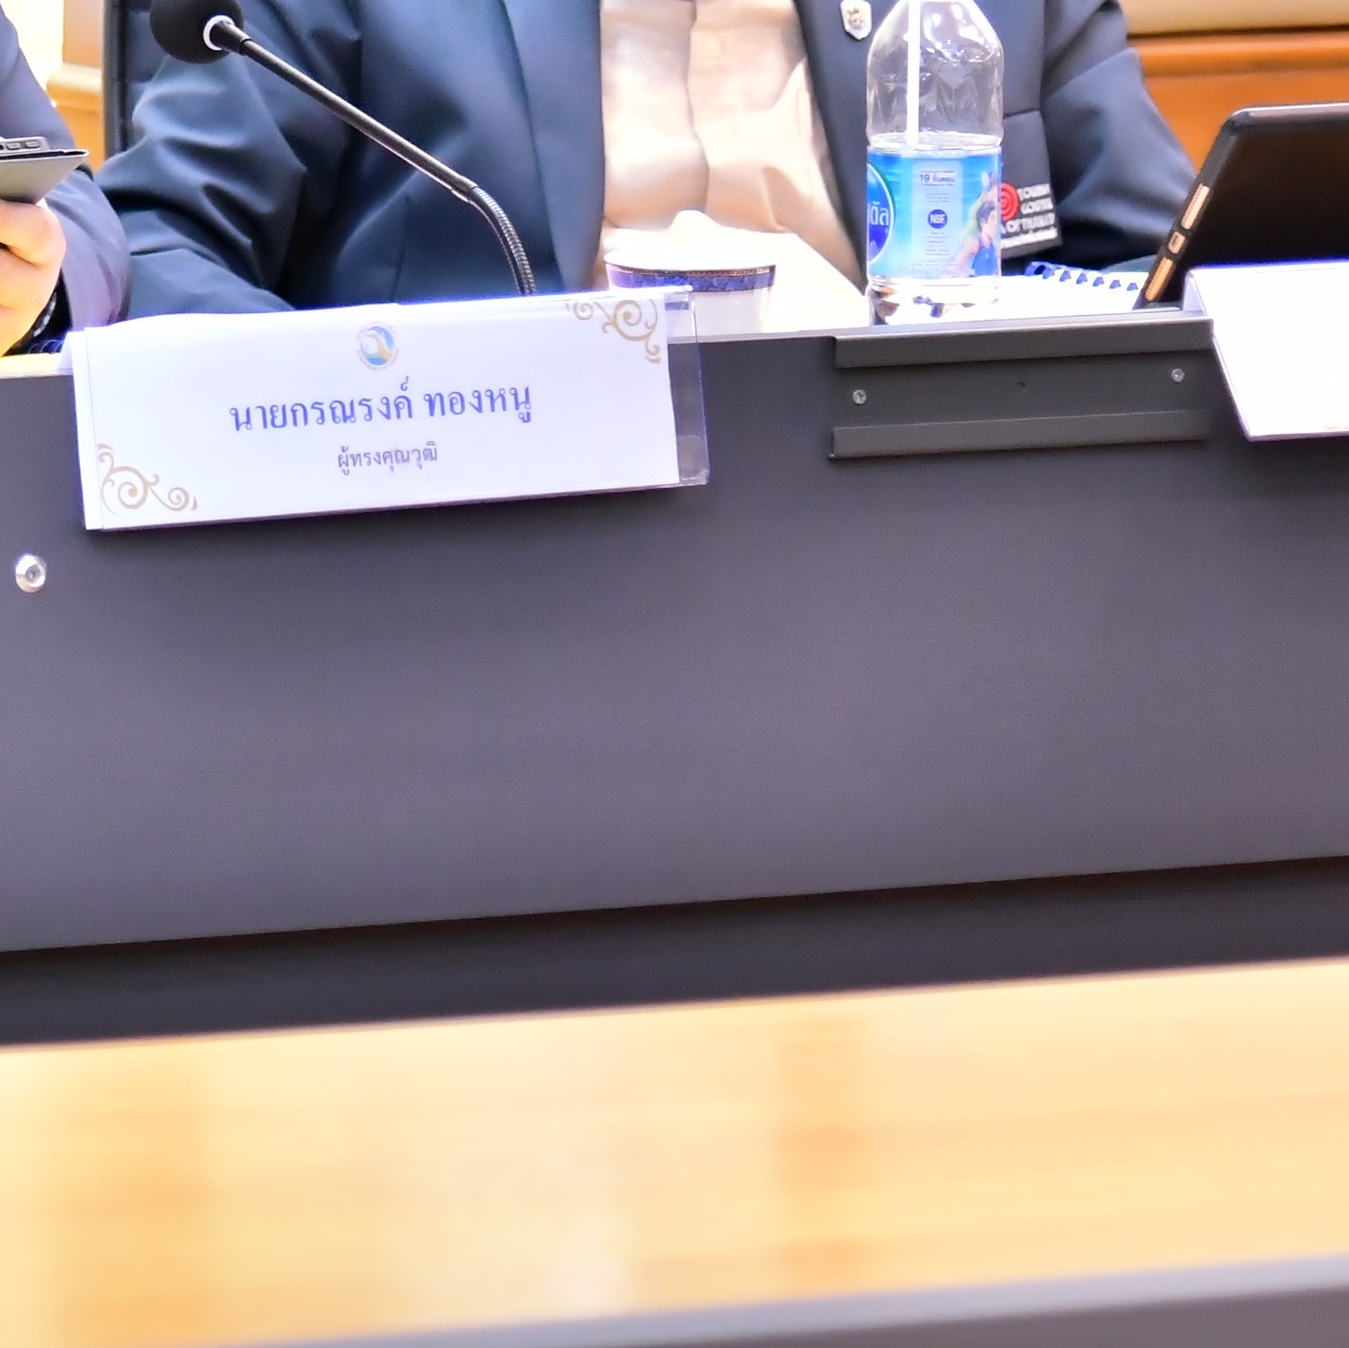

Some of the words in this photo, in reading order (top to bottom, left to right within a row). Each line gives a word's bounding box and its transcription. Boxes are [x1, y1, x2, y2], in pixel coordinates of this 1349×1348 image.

[229, 375, 413, 431] นายกรณรงค์
[423, 385, 533, 424] ทองหนู
[337, 440, 439, 476] ผู้ทรงคุณวุฒิ
